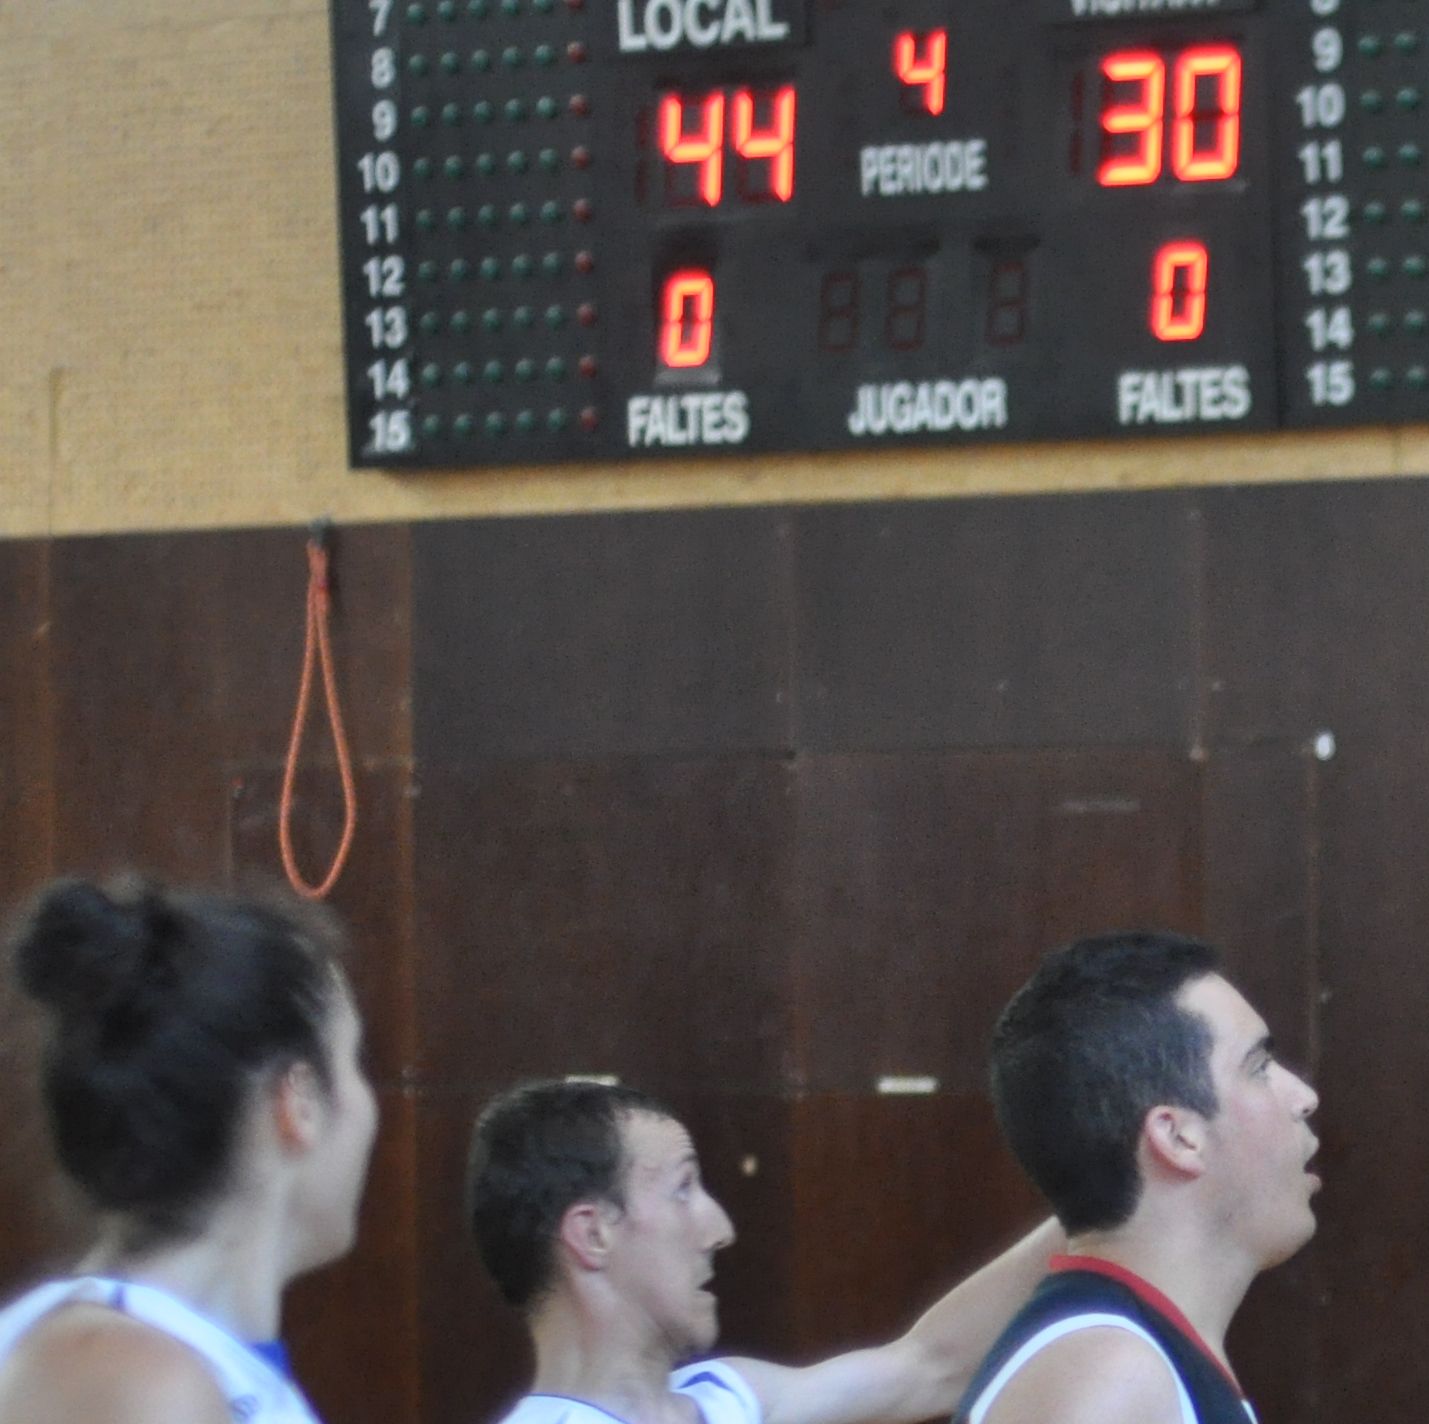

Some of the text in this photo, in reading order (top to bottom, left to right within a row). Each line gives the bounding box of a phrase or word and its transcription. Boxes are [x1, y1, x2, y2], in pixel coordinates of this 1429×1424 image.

[369, 0, 392, 37] 7
[618, 0, 791, 52] LOCAL
[370, 47, 396, 89] 8
[894, 27, 948, 116] 4
[1311, 29, 1344, 74] 9
[372, 101, 398, 142] 9
[1097, 45, 1242, 186] 30
[1297, 82, 1347, 129] 10
[660, 88, 796, 207] 44
[860, 139, 988, 196] PERIODE
[1299, 139, 1345, 184] 11
[358, 151, 400, 193] 10
[360, 203, 400, 244] 11
[1301, 195, 1351, 240] 12
[363, 256, 405, 298] 12
[1150, 239, 1209, 343] 0
[1304, 249, 1354, 296] 13
[365, 306, 408, 348] 13
[660, 268, 716, 368] 0
[1305, 306, 1355, 352] 14
[367, 359, 410, 400] 14
[1117, 365, 1251, 426] FALTES
[1306, 361, 1356, 407] 15
[627, 391, 750, 448] FALTES
[849, 378, 1007, 435] JUGADOR
